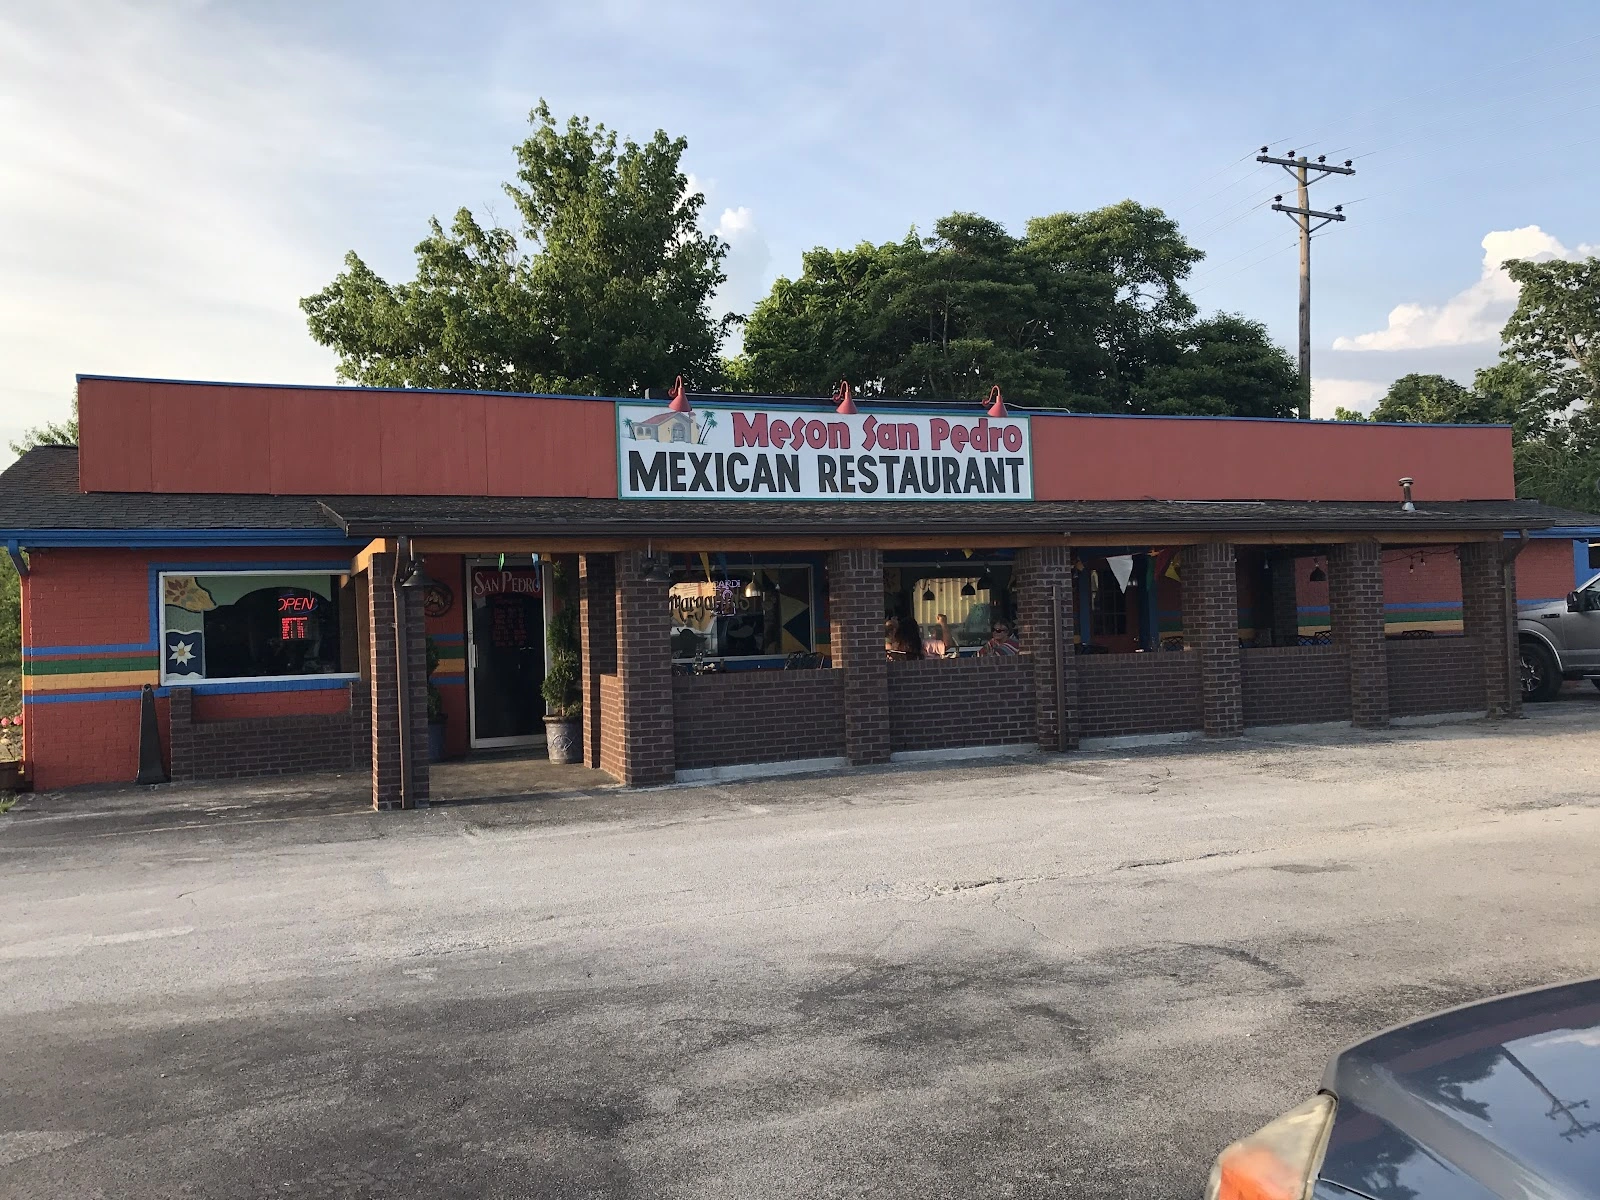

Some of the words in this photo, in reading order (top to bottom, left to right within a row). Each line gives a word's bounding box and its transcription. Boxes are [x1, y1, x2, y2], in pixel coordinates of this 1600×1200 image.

[731, 411, 851, 451] Meson
[862, 414, 920, 452] San
[929, 417, 1023, 453] Pedro
[628, 451, 800, 493] MEXICAN
[818, 454, 1024, 494] RESTAURANT
[474, 571, 499, 595] SAN
[501, 571, 541, 593] PEDRO
[277, 597, 315, 612] OPEN
